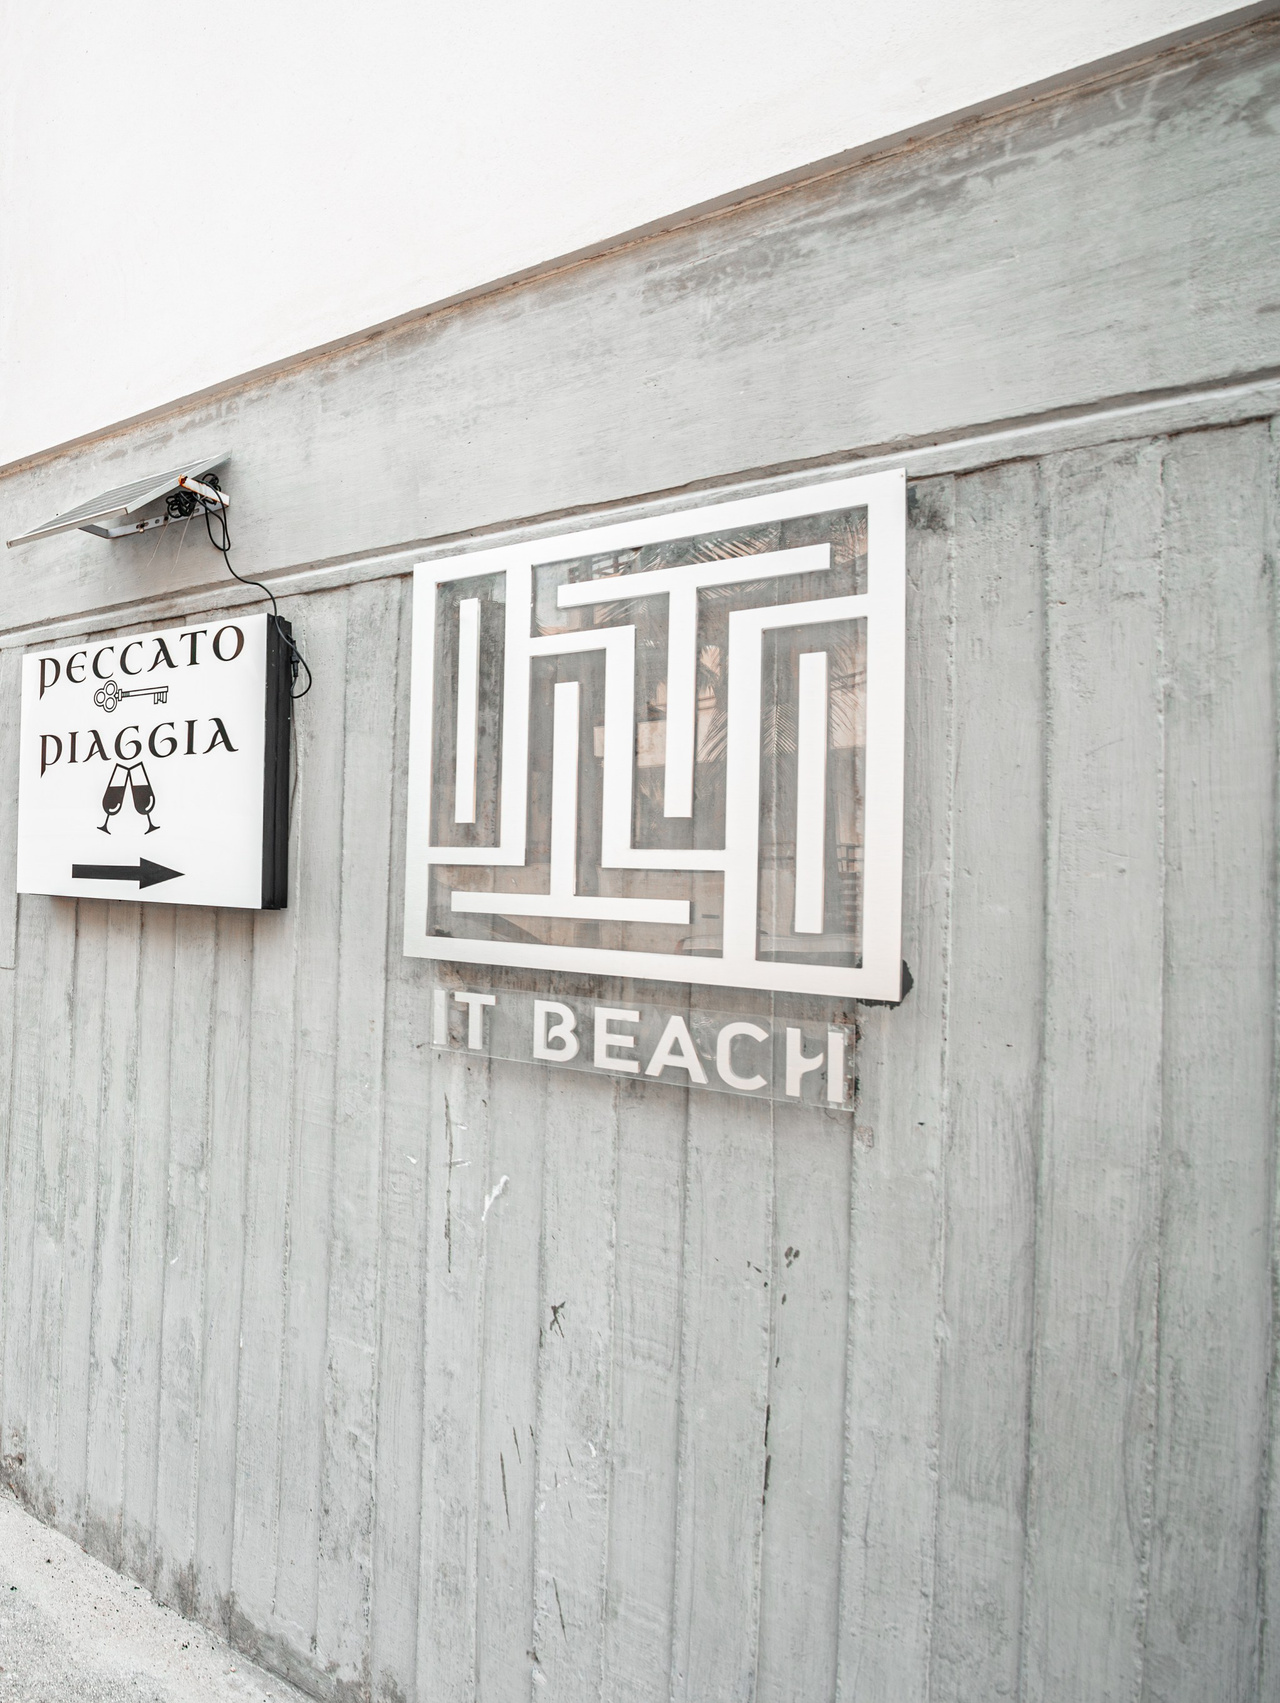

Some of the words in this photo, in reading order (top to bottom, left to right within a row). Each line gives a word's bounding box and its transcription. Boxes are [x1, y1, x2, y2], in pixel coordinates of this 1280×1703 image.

[38, 625, 245, 700] PECCATO
[39, 717, 239, 778] PIAGGIA
[432, 989, 496, 1051] IT
[533, 999, 845, 1103] BEACH
